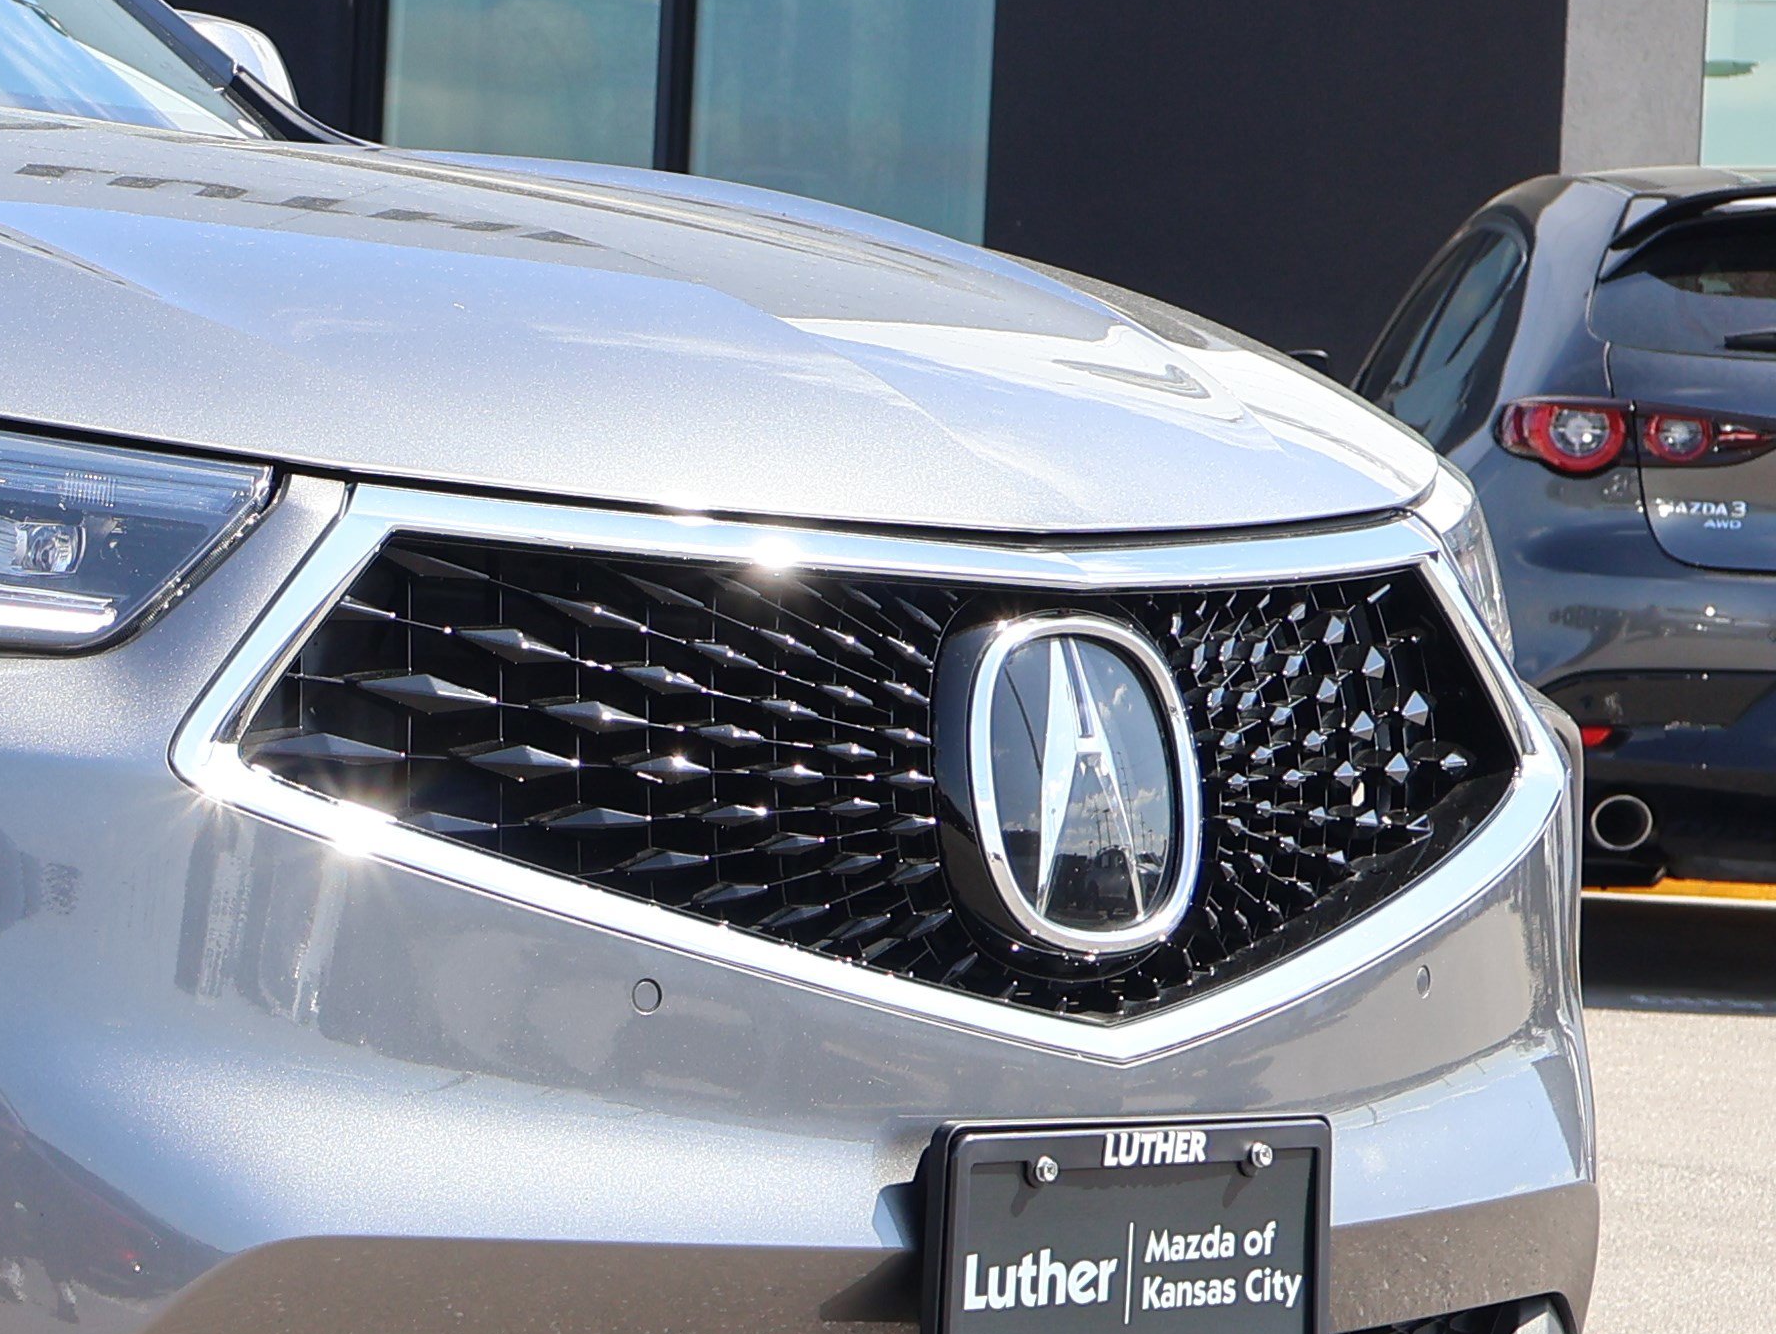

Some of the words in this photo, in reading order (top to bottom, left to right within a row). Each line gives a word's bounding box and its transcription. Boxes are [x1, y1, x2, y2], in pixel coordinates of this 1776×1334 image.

[1703, 518, 1742, 530] AWD
[1104, 1130, 1207, 1167] LUTHER
[1145, 1223, 1235, 1263] Mazda
[1243, 1220, 1276, 1257] of
[963, 1248, 1118, 1311] Luther
[1141, 1274, 1236, 1310] Kansas
[1245, 1267, 1302, 1308] City
